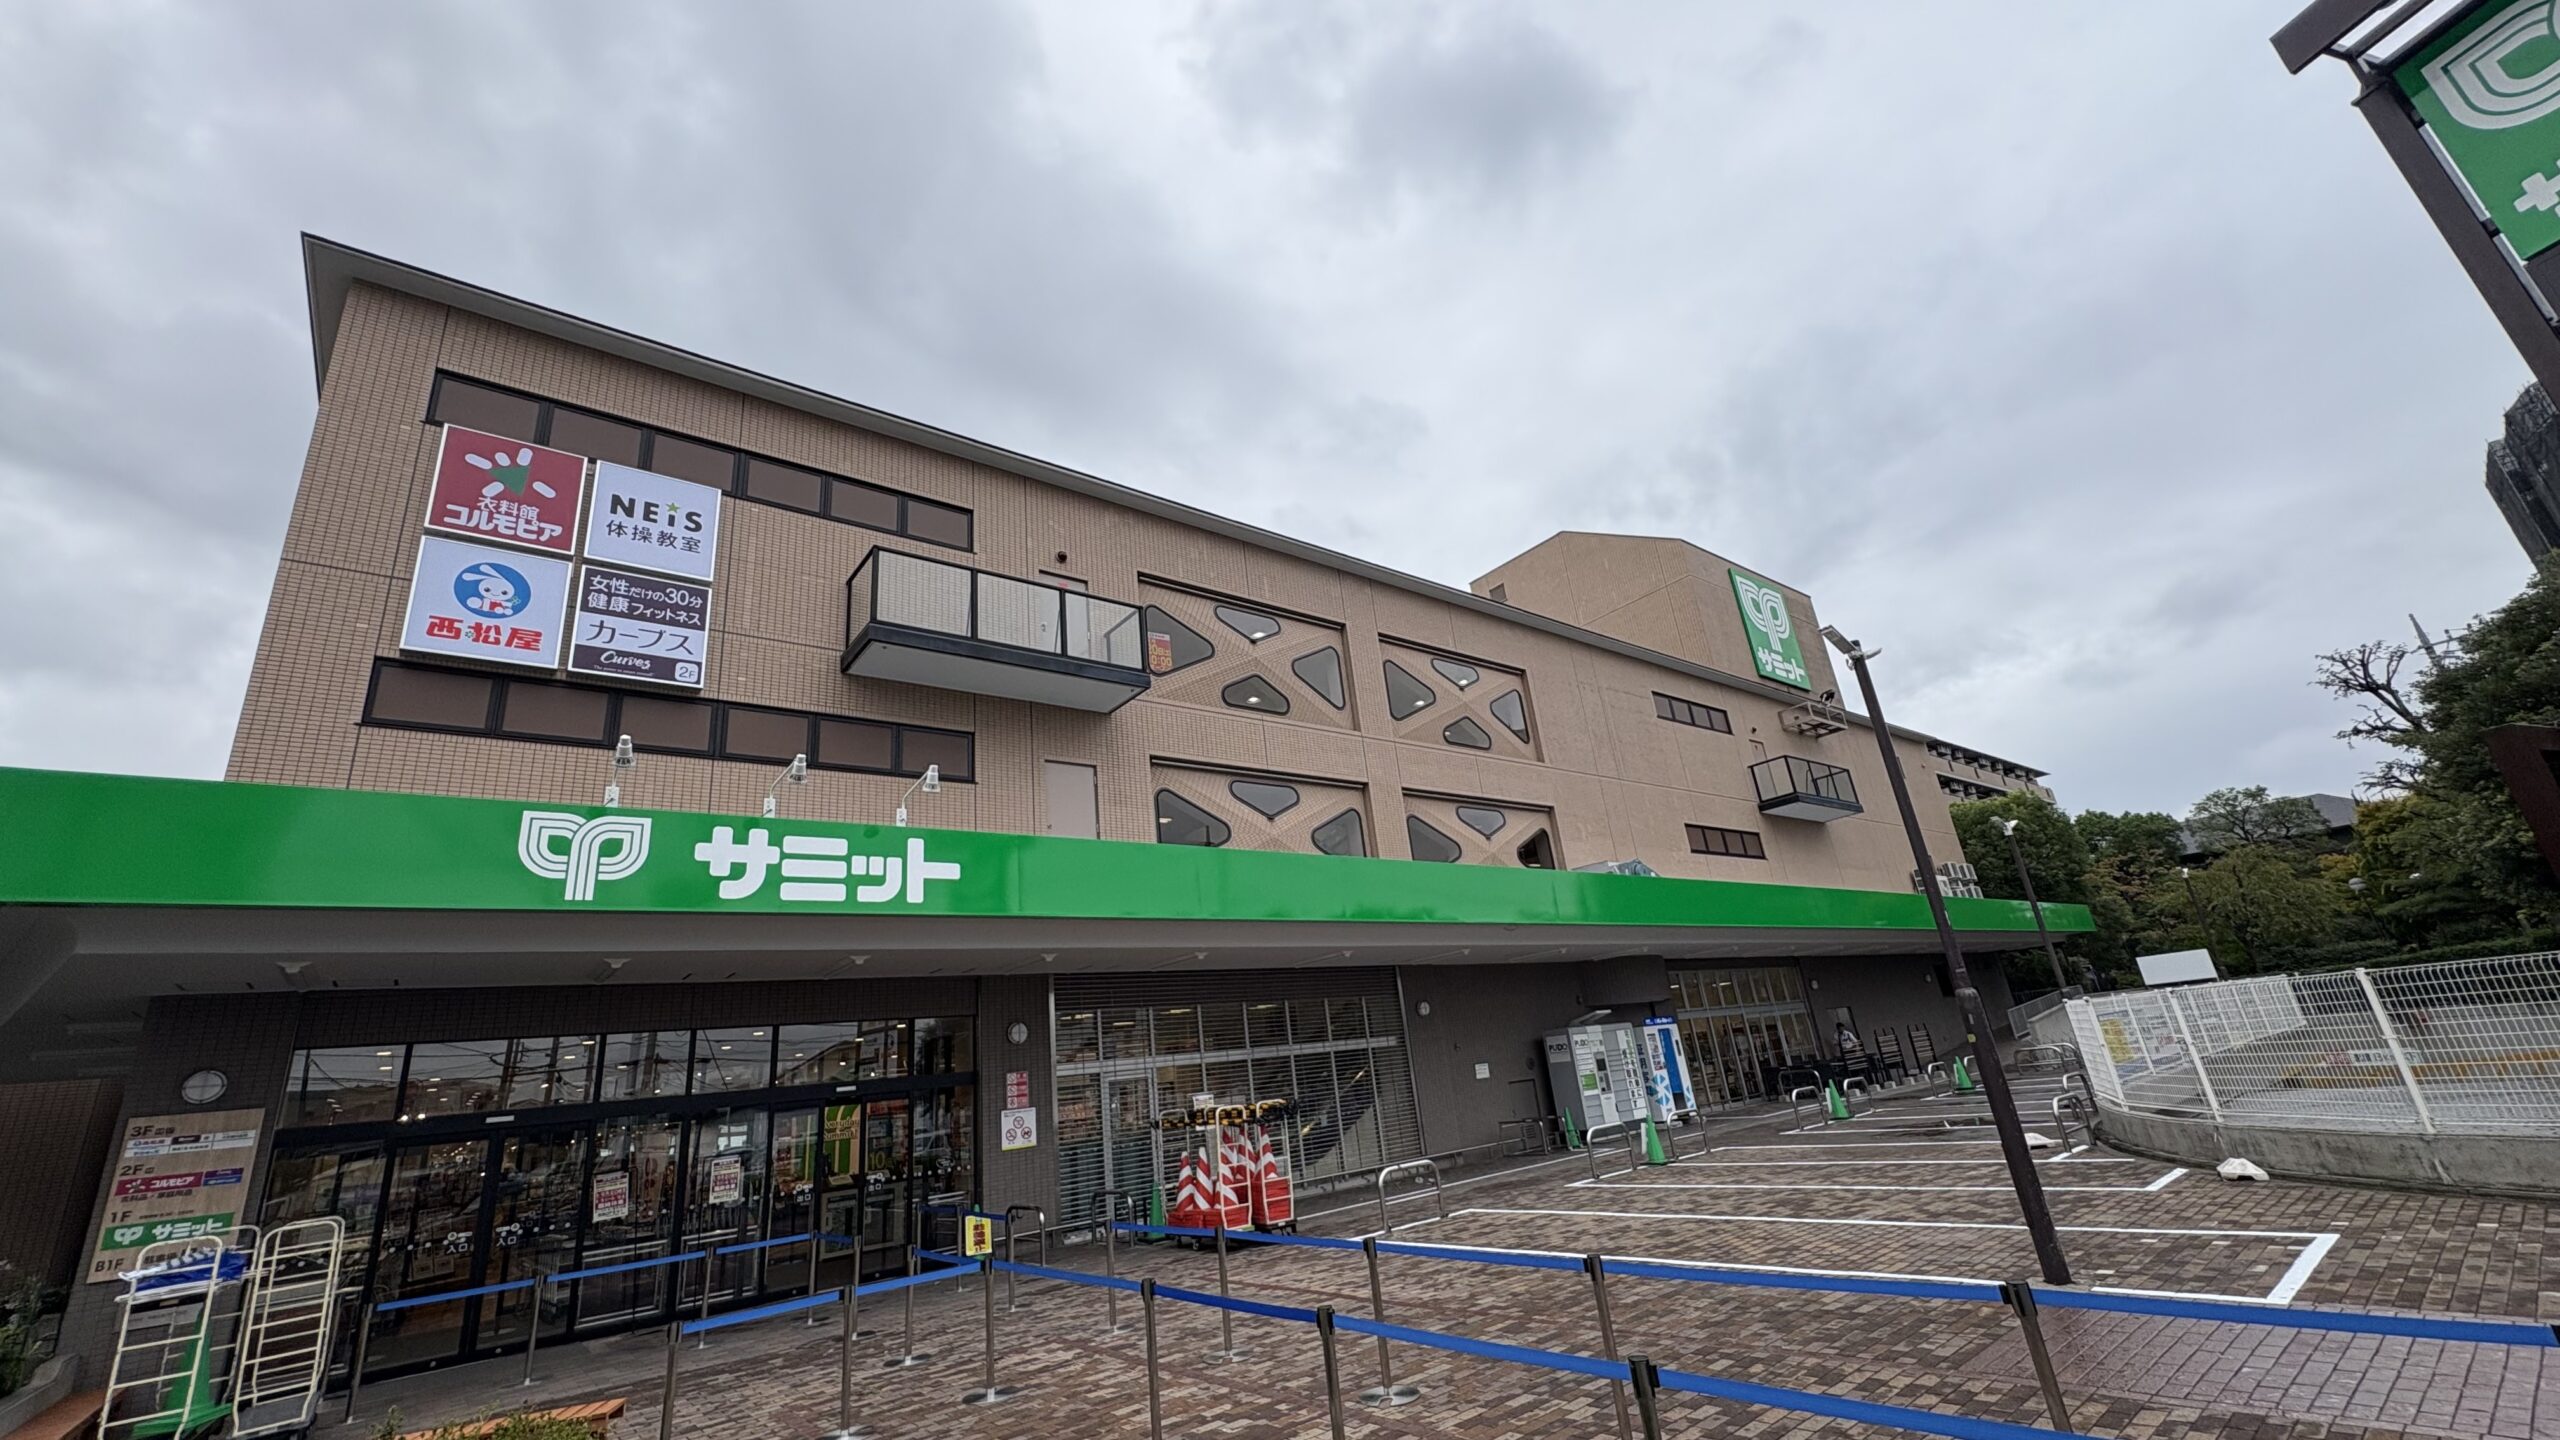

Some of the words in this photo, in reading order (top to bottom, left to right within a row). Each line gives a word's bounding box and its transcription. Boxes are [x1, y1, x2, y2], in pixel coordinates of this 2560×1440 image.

[477, 496, 539, 520] 衣料館
[443, 503, 562, 542] コルモピア
[606, 520, 702, 554] 体操教室
[589, 574, 703, 608] 女性だけの30分
[587, 591, 702, 626] 健康フィットネス
[425, 614, 544, 652] 西松屋
[585, 619, 694, 656] カーブス
[600, 650, 651, 670] Curves
[1757, 646, 1805, 682] サミット
[678, 666, 697, 679] 2F
[694, 826, 961, 904] サミット
[1548, 1043, 1568, 1052] PUDO
[130, 1125, 154, 1138] 3F
[119, 1164, 144, 1177] 2F
[150, 1176, 195, 1189] コルモピア
[111, 1210, 133, 1223] 1F
[152, 1218, 224, 1241] サミット
[446, 1242, 468, 1254] 入口
[496, 1236, 517, 1247] 入口
[95, 1258, 123, 1273] B1F
